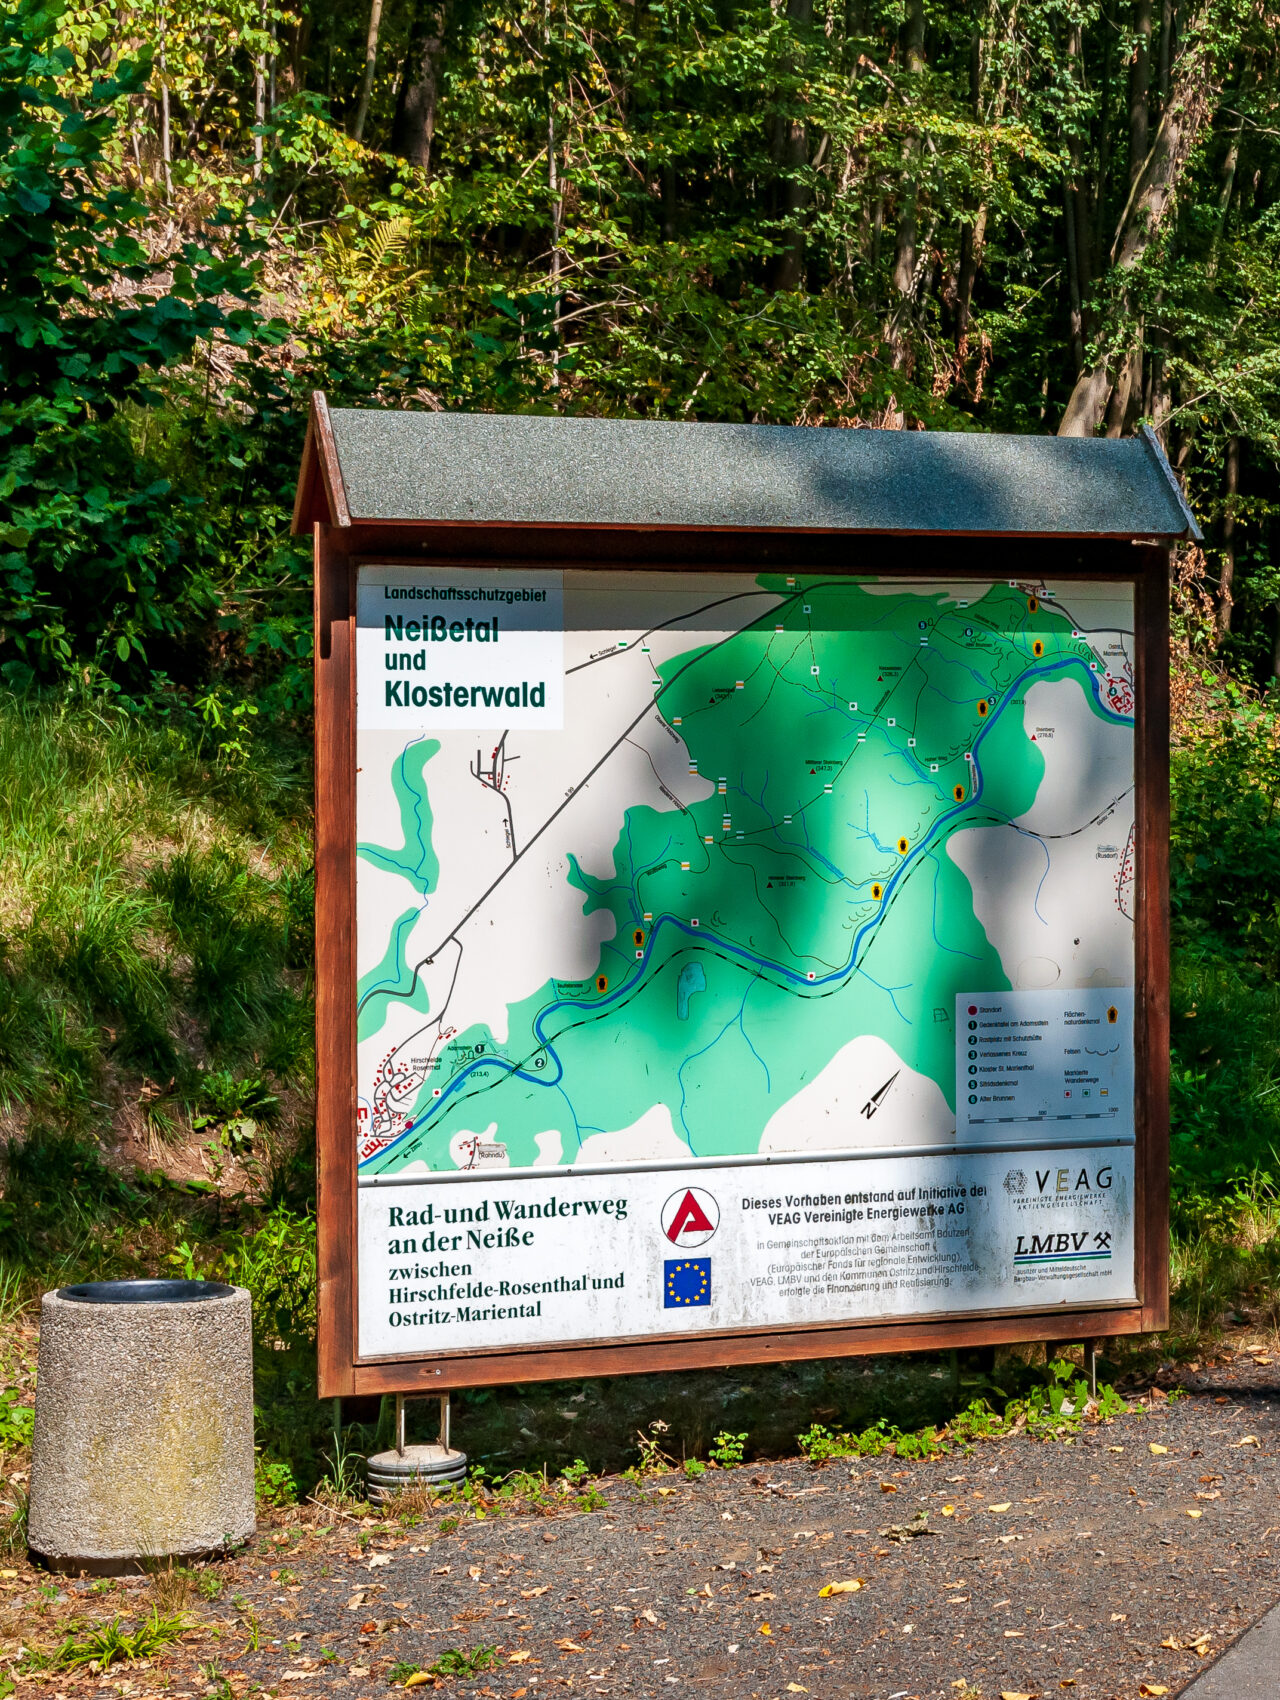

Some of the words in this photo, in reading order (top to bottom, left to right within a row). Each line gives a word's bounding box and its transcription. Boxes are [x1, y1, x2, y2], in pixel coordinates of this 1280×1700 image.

[385, 586, 547, 604] Landschaftsschutzgebiet
[385, 615, 499, 642] Neißetal
[385, 649, 426, 670] und
[385, 680, 545, 708] Klosterwald
[1035, 1167, 1112, 1193] VEAG
[493, 1196, 628, 1221] Wanderweg
[742, 1197, 782, 1210] Dieses
[785, 1194, 841, 1207] Vorhaben
[844, 1190, 894, 1204] entstand
[897, 1187, 916, 1201] auf
[919, 1186, 966, 1200] Initiative
[768, 1212, 801, 1225] VEAG
[804, 1208, 864, 1224] Vereinigte
[867, 1204, 945, 1221] Energiewerke
[948, 1203, 965, 1214] AG
[388, 1238, 418, 1255] an
[422, 1231, 462, 1253] der
[466, 1227, 535, 1250] Neiße
[856, 1235, 869, 1244] mit
[892, 1230, 935, 1241] Arbeitsamt
[1015, 1232, 1089, 1255] LMBV
[801, 1250, 815, 1259] der
[816, 1245, 872, 1259] Europäischen
[874, 1242, 930, 1255] Gemeinschaft
[389, 1261, 472, 1281] zwischen
[855, 1258, 866, 1268] für
[389, 1274, 588, 1304] Hirschfelde-Rosenthal
[592, 1272, 625, 1290] und
[777, 1274, 802, 1285] LMBV
[804, 1273, 820, 1283] und
[822, 1272, 838, 1282] den
[882, 1279, 898, 1290] und
[389, 1301, 542, 1327] Ostritz-Mariental
